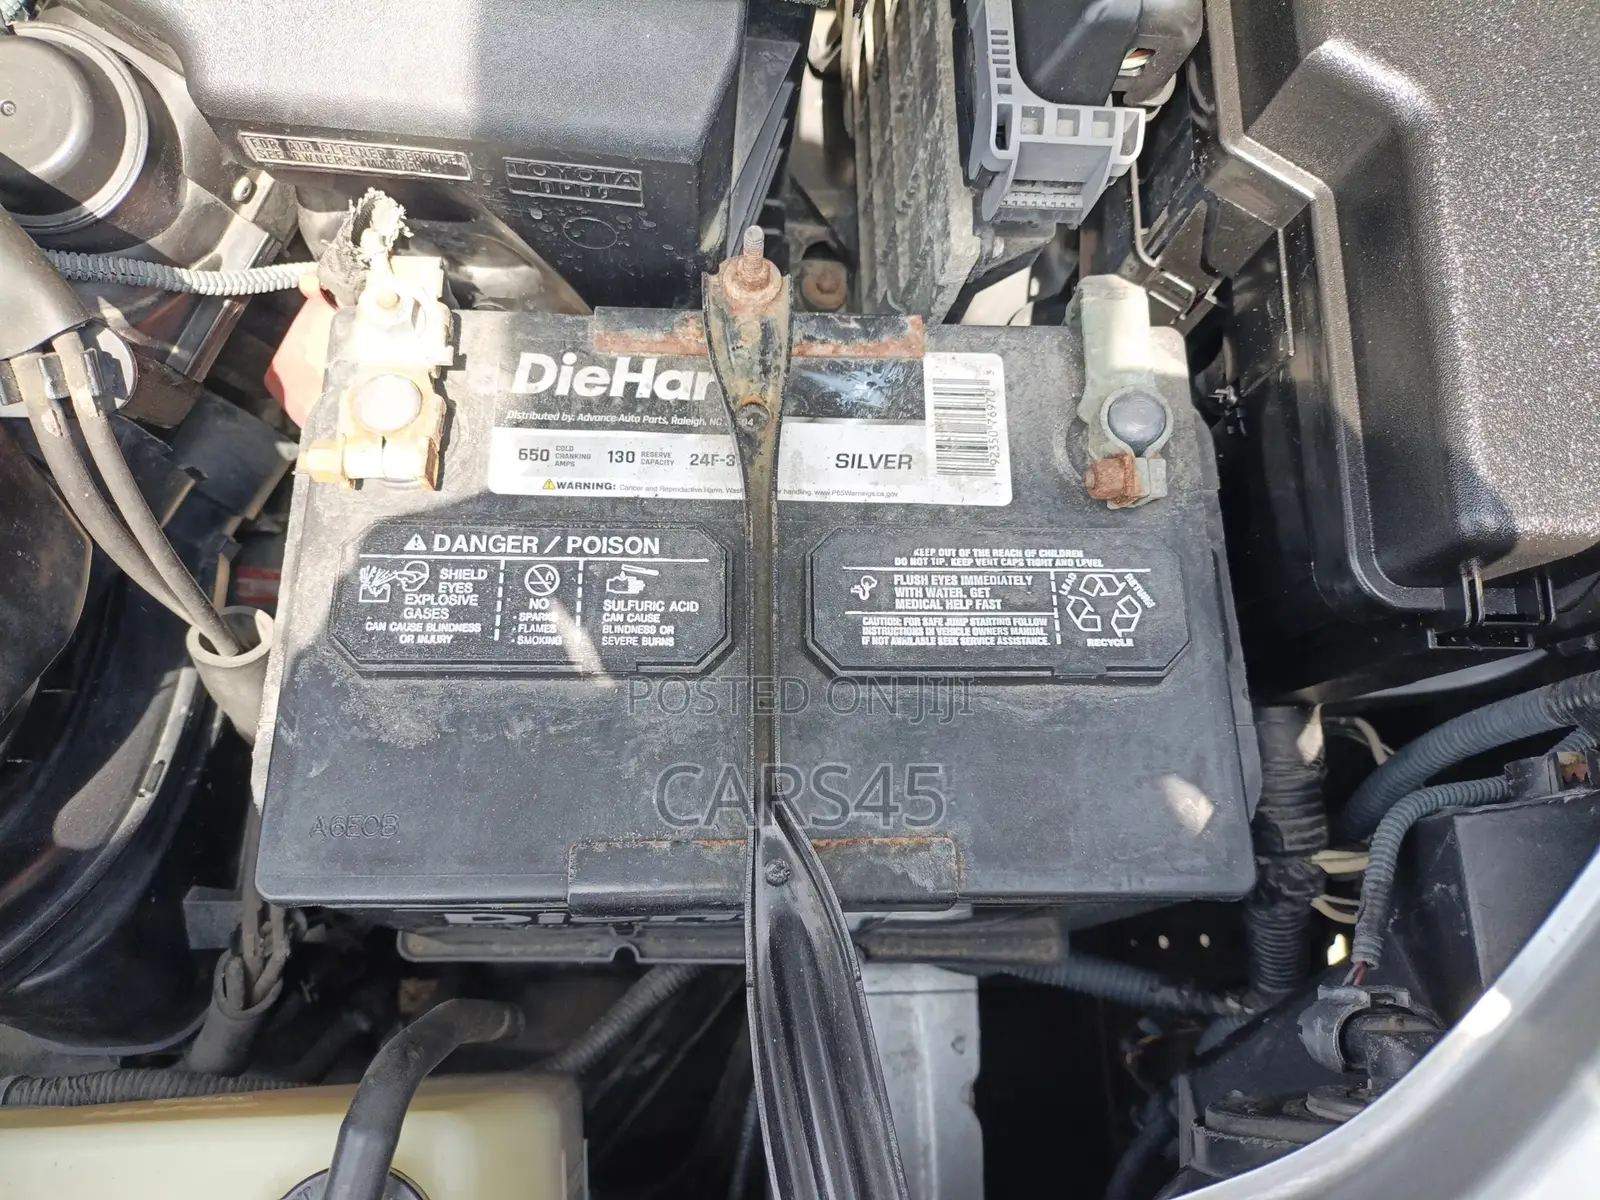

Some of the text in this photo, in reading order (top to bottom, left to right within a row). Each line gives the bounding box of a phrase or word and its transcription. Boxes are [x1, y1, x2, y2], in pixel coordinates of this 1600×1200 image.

[249, 137, 280, 151] FOR
[286, 140, 315, 153] AIR
[319, 143, 388, 159] CLEANER
[256, 148, 285, 159] SEE
[505, 160, 642, 189] TOYOTA
[510, 351, 718, 401] DieHar
[985, 387, 997, 426] 76970
[507, 410, 560, 422] Distributed
[561, 412, 576, 423] by:
[576, 412, 617, 423] Advance
[618, 413, 641, 423] Auto
[642, 414, 669, 426] Parts,
[710, 417, 723, 426] NC
[555, 444, 575, 452] COLD
[987, 430, 1000, 467] 92350
[518, 447, 550, 463] 650
[607, 450, 636, 464] 130
[640, 451, 673, 459] RESERVE
[834, 452, 913, 470] SILVER
[554, 460, 576, 468] AMPS
[640, 458, 675, 467] CAPACITY
[556, 480, 617, 492] WARNING:
[619, 483, 643, 492] Cancer
[659, 485, 703, 495] Reproductive
[433, 533, 539, 554] DANGER
[567, 535, 660, 555] POISON
[913, 547, 1084, 558] KEEP OUT OF THE REACH OF CHILDREN
[894, 556, 1104, 568] DO NOT TIP. KEEP VENT CAPS TIGHT AND LEVEL
[439, 567, 488, 581] SHIELD
[894, 574, 1033, 586] FLUSH EYES IMMEDIATELY
[438, 581, 474, 594] EYES
[1058, 572, 1077, 596] LEAD
[895, 587, 924, 598] WITH
[969, 587, 991, 598] GET
[1123, 572, 1156, 609] RETURN
[404, 593, 479, 607] EXPLOSIVE
[528, 598, 549, 610] NO
[602, 599, 699, 613] SULFURIC ACID
[895, 599, 1003, 610] MEDICAL HELP FAST
[403, 607, 450, 620] GASES
[518, 612, 560, 623] SPARKS
[602, 612, 661, 624] CAN CAUSE
[365, 621, 482, 633] CAN CAUSE BLINDNESS
[862, 616, 1048, 627] CAUTION: FOR SAFE JUMP STARTING FOLLOW
[517, 623, 557, 634] FLAMES
[602, 624, 675, 635] BLINDNESS OR
[862, 626, 925, 636] INSTRUCTIONS
[925, 626, 935, 636] IN
[935, 626, 971, 636] VEHICLE
[971, 626, 1010, 636] OWNERS
[399, 633, 454, 645] OR INJURY
[517, 635, 562, 646] SMOKING
[601, 636, 675, 647] SEVERE BURNS
[861, 636, 871, 646] IF
[871, 636, 890, 646] NOT
[890, 636, 937, 646] AVAILABLE
[937, 636, 960, 646] SEEK
[960, 636, 996, 646] SERVICE
[1086, 638, 1134, 647] RECYCLE
